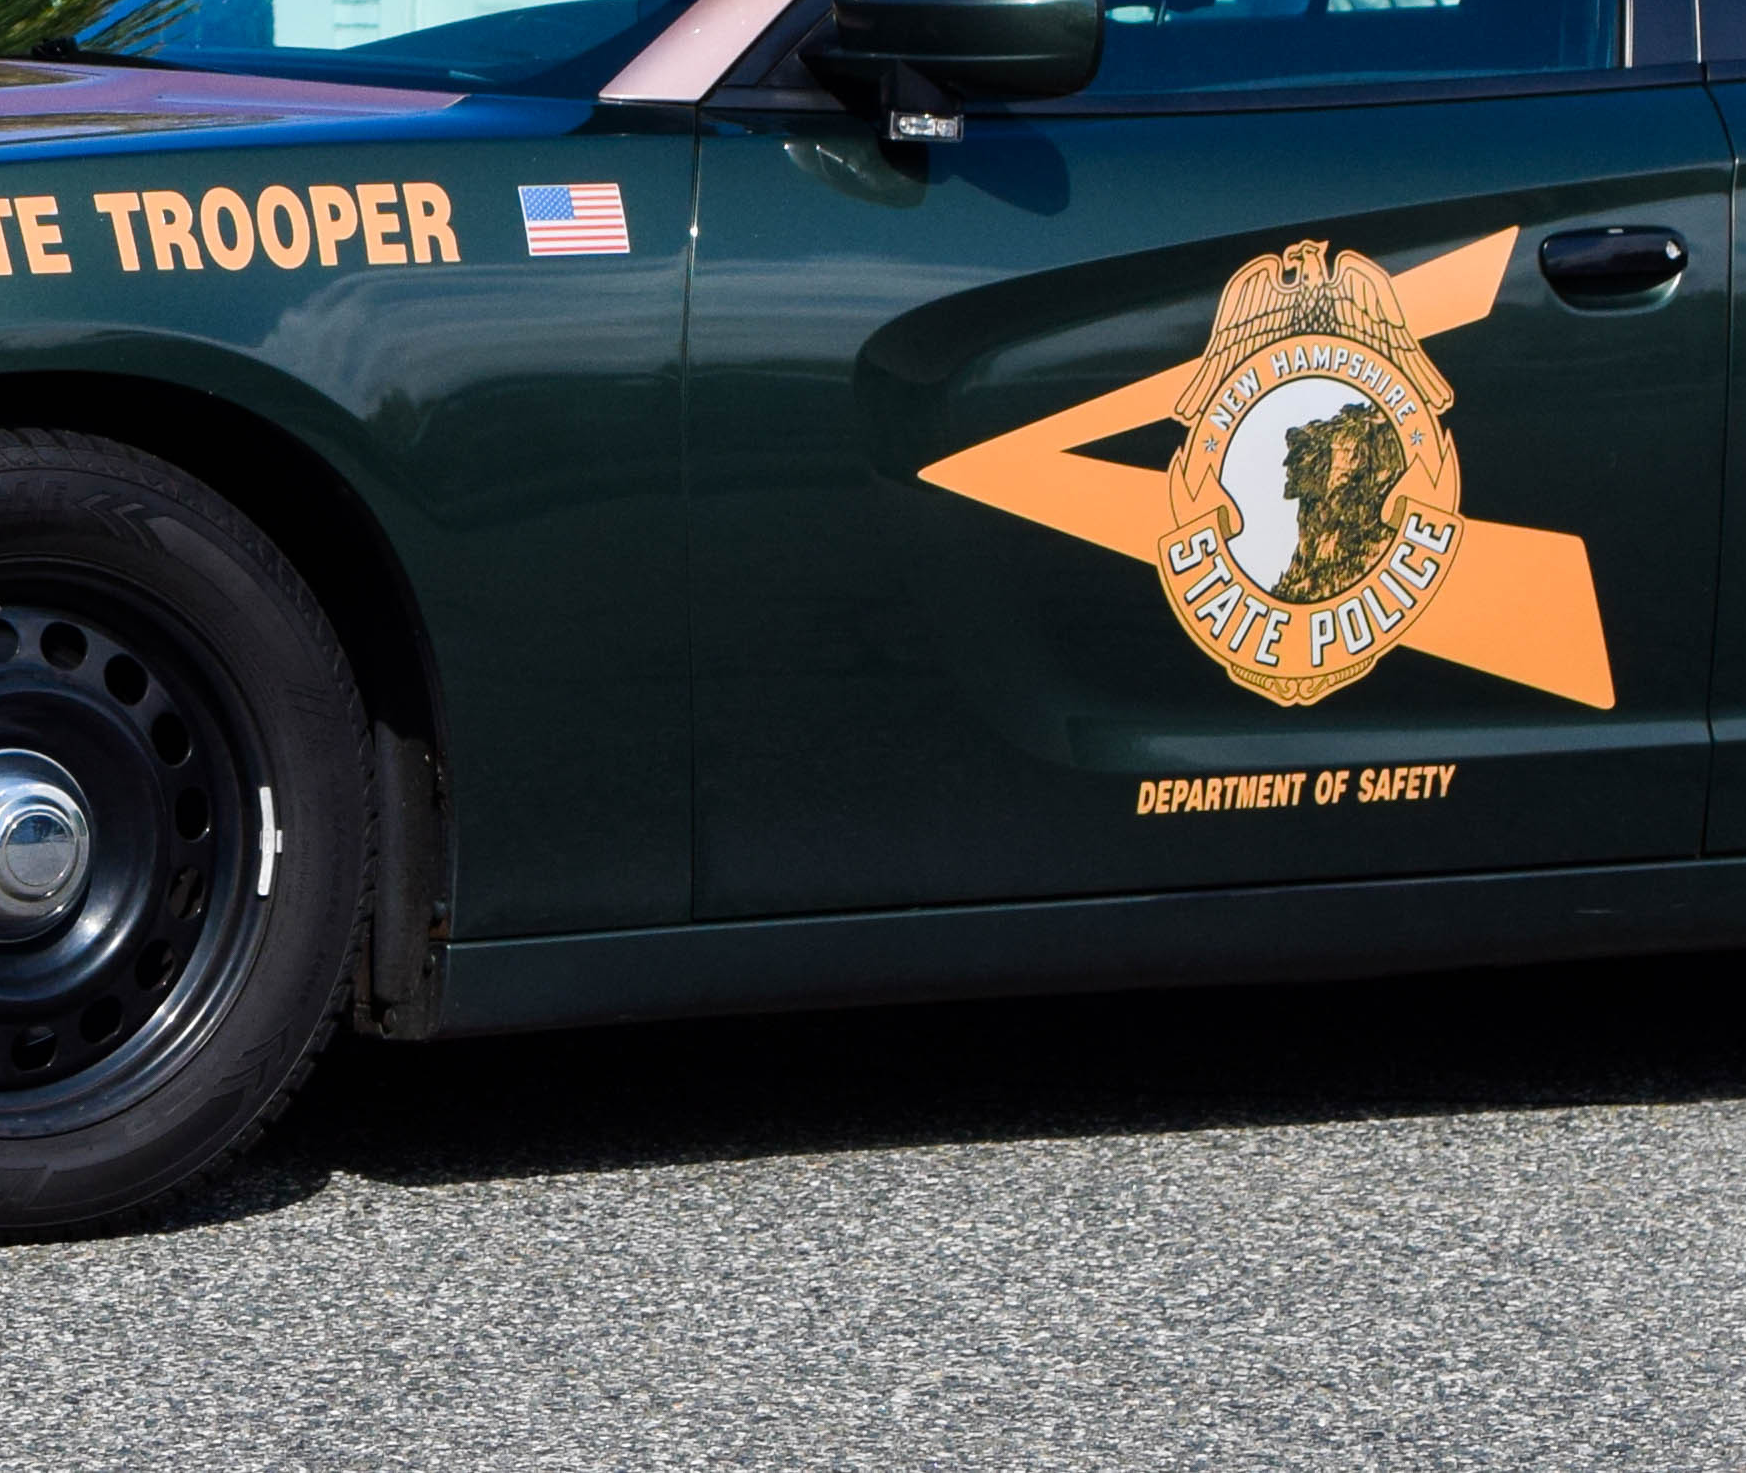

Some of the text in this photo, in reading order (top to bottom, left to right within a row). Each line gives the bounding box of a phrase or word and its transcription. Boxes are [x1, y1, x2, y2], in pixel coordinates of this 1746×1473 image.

[93, 182, 460, 272] TROOPER
[1211, 344, 1417, 431] NEW HAMPSHIRE
[1169, 511, 1455, 668] STATE POLICE
[1137, 765, 1455, 815] DEPARTMENT OF SAFETY
